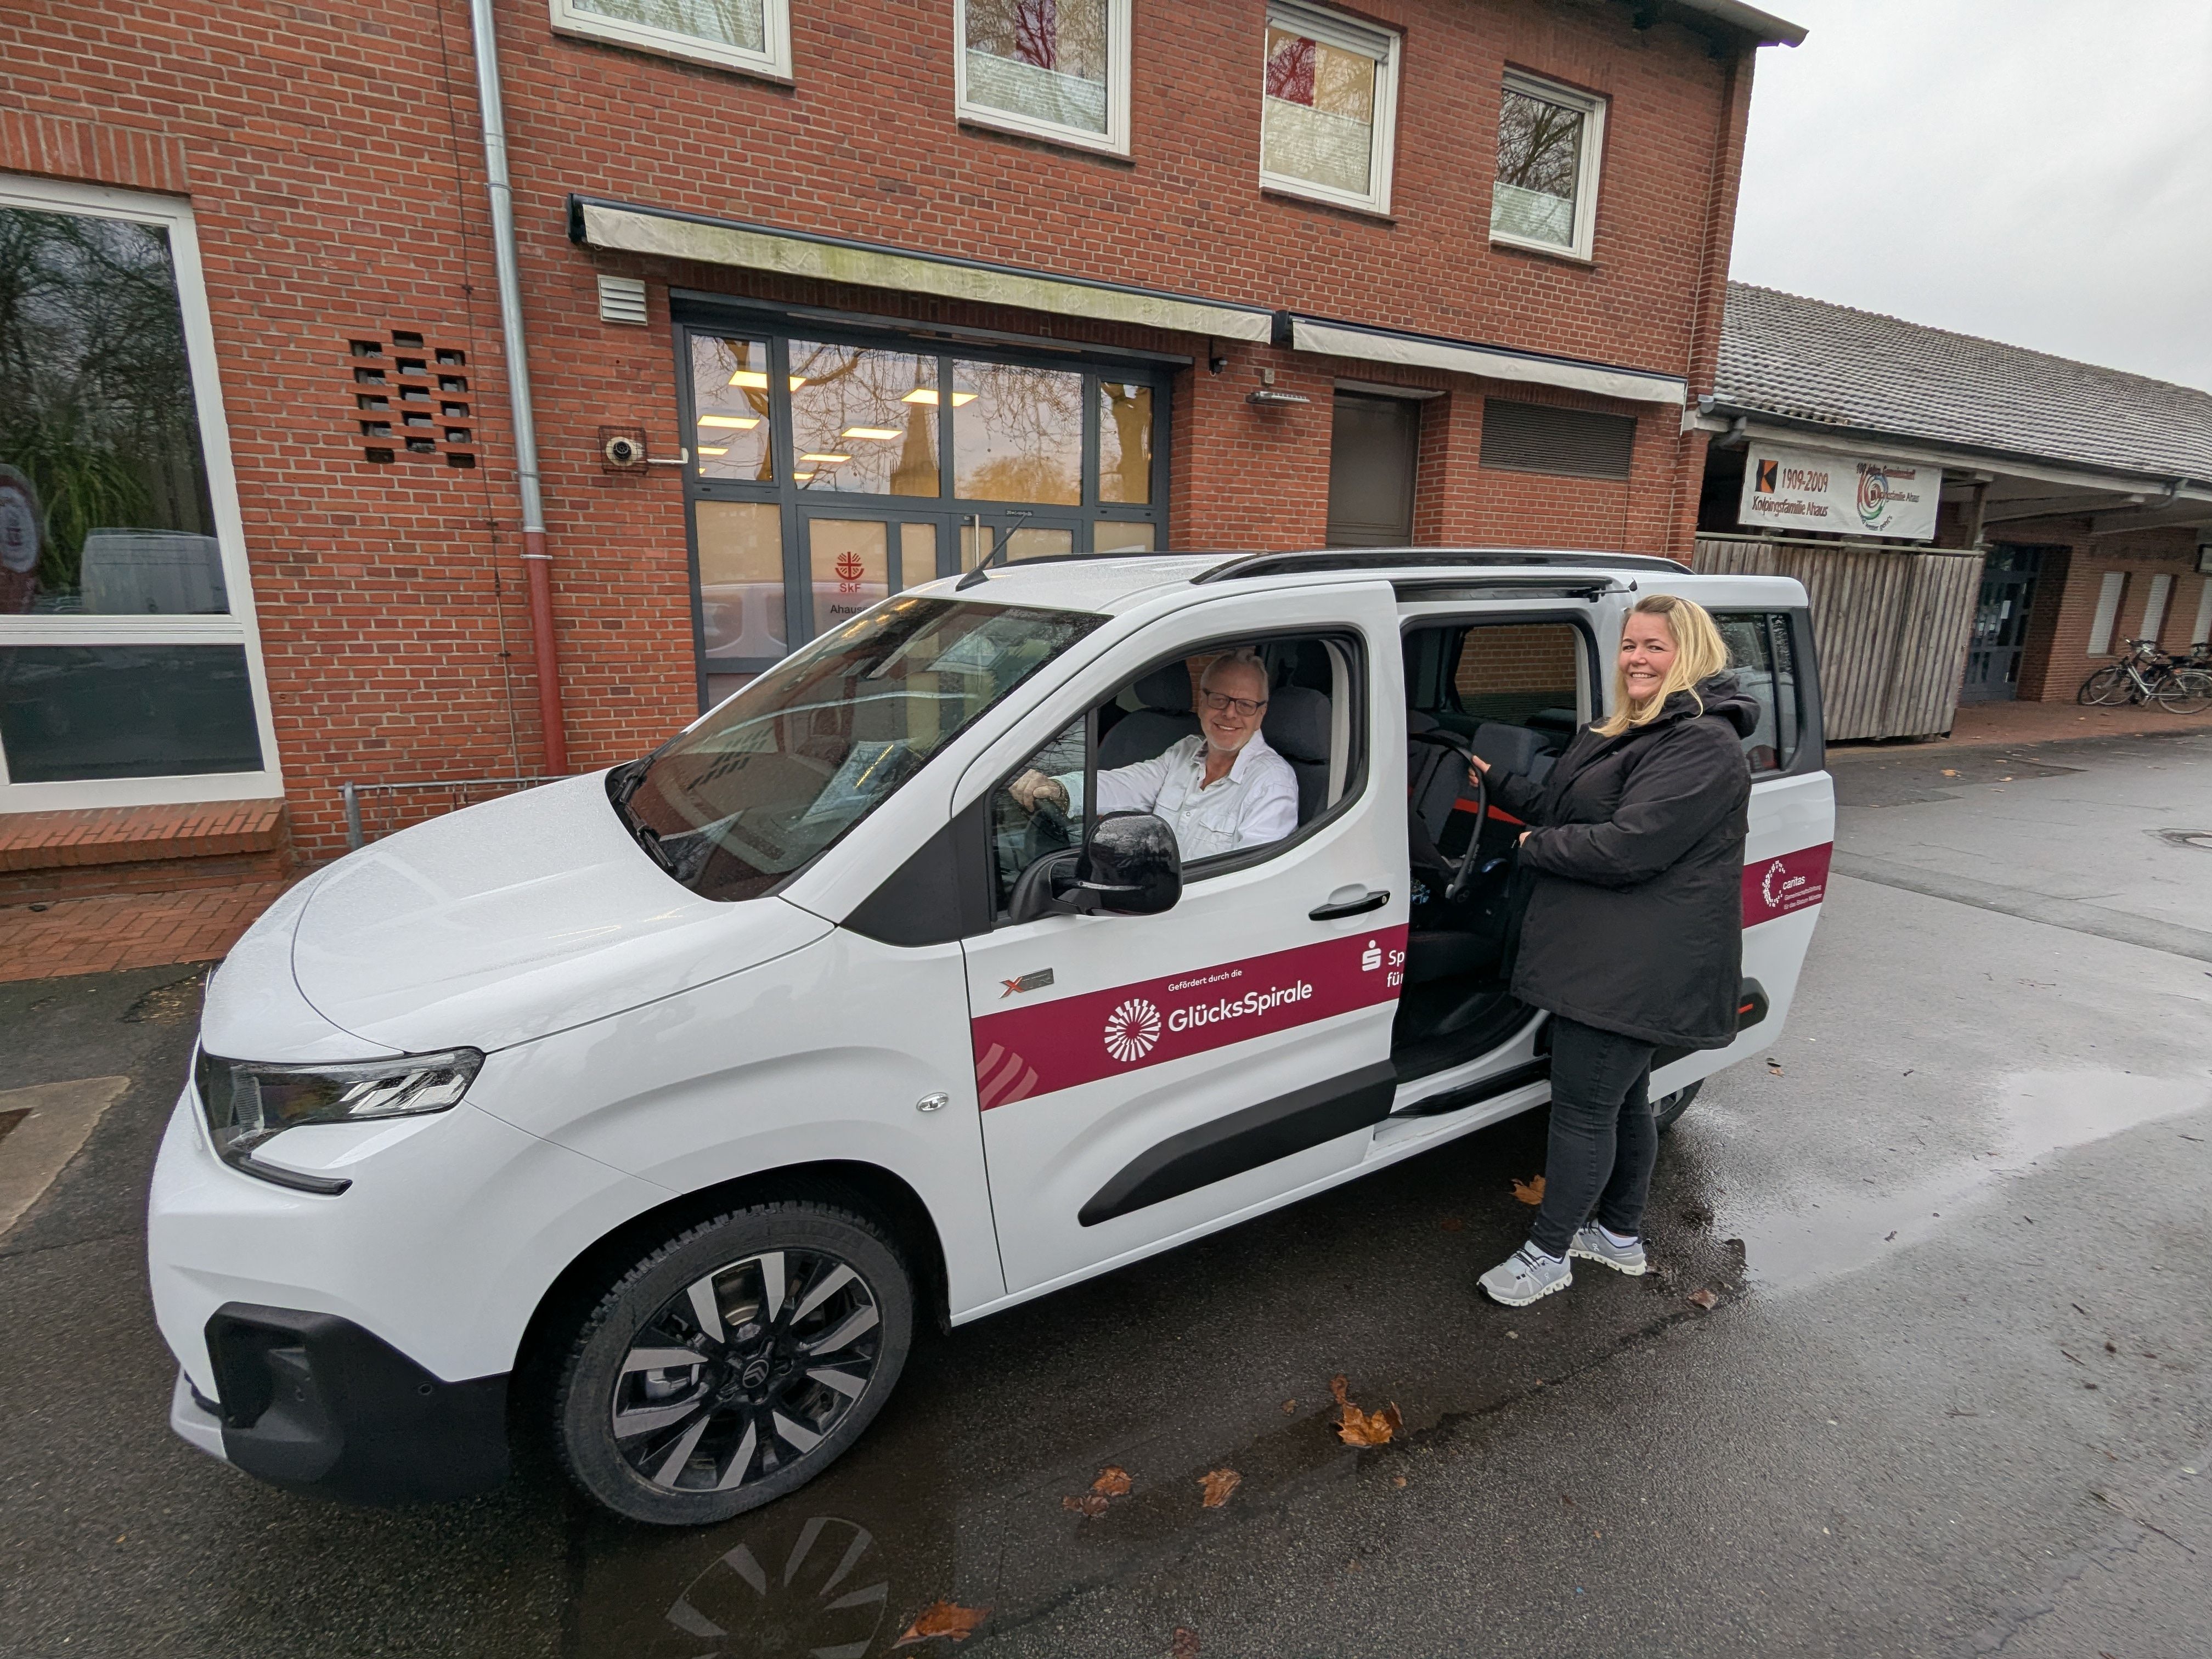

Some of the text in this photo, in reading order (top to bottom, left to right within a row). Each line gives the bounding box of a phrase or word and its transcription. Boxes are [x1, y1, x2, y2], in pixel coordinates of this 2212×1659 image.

[1782, 468, 1829, 493] 1909-2009
[1752, 496, 1829, 517] Kolpingsfamilie Ahaus
[840, 583, 861, 592] SkF
[1783, 876, 1805, 890] caritas
[1168, 969, 1242, 991] Gefördert durch die
[1168, 980, 1312, 1032] GlücksSpirale
